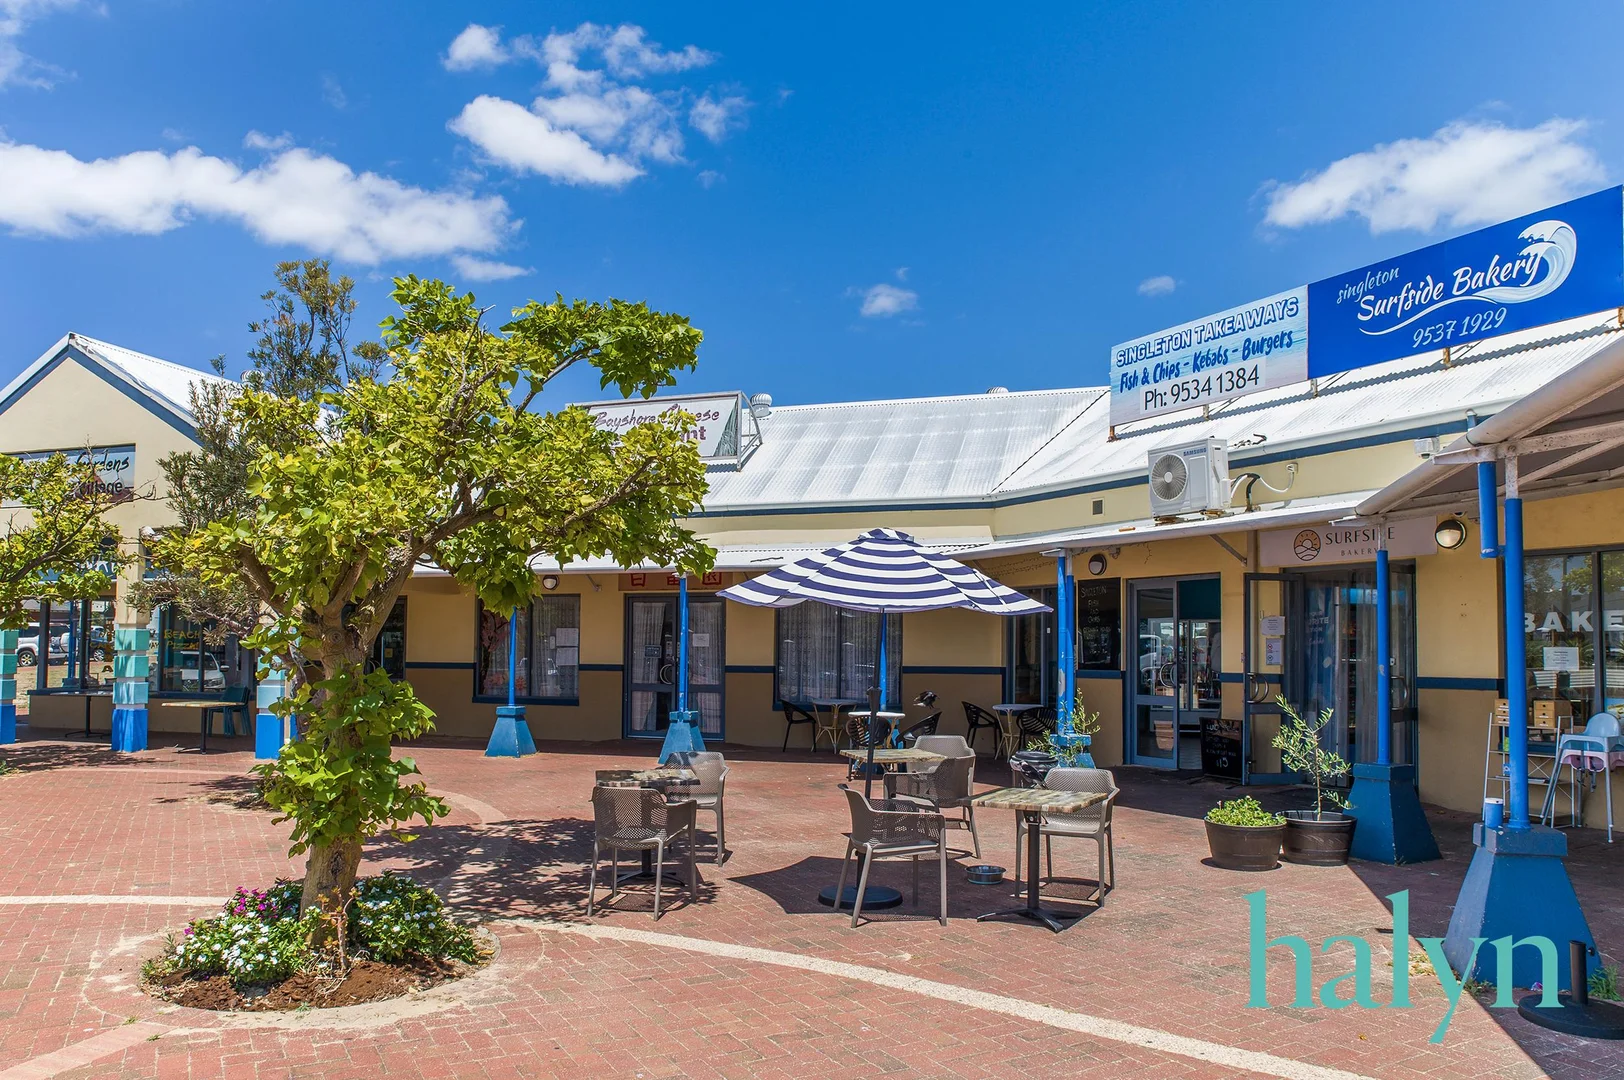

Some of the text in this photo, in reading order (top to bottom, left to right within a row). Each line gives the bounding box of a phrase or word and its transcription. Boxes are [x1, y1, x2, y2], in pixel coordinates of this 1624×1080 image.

[1336, 265, 1400, 304] singleton
[1357, 252, 1542, 321] Surfside Bakery
[1116, 296, 1299, 368] SINGLETON TAKEAWAYS
[1412, 306, 1508, 348] 9537 1929
[1119, 371, 1139, 393] Fish
[1140, 367, 1150, 386] &
[1152, 361, 1181, 385] Chips
[1192, 345, 1229, 373] Kebabs
[1241, 330, 1293, 361] Burgers
[1144, 364, 1260, 411] Ph: 9534 1384
[594, 408, 656, 433] Bayshore
[1183, 447, 1207, 457] SAMSUNG
[1325, 526, 1396, 546] SURFSIE
